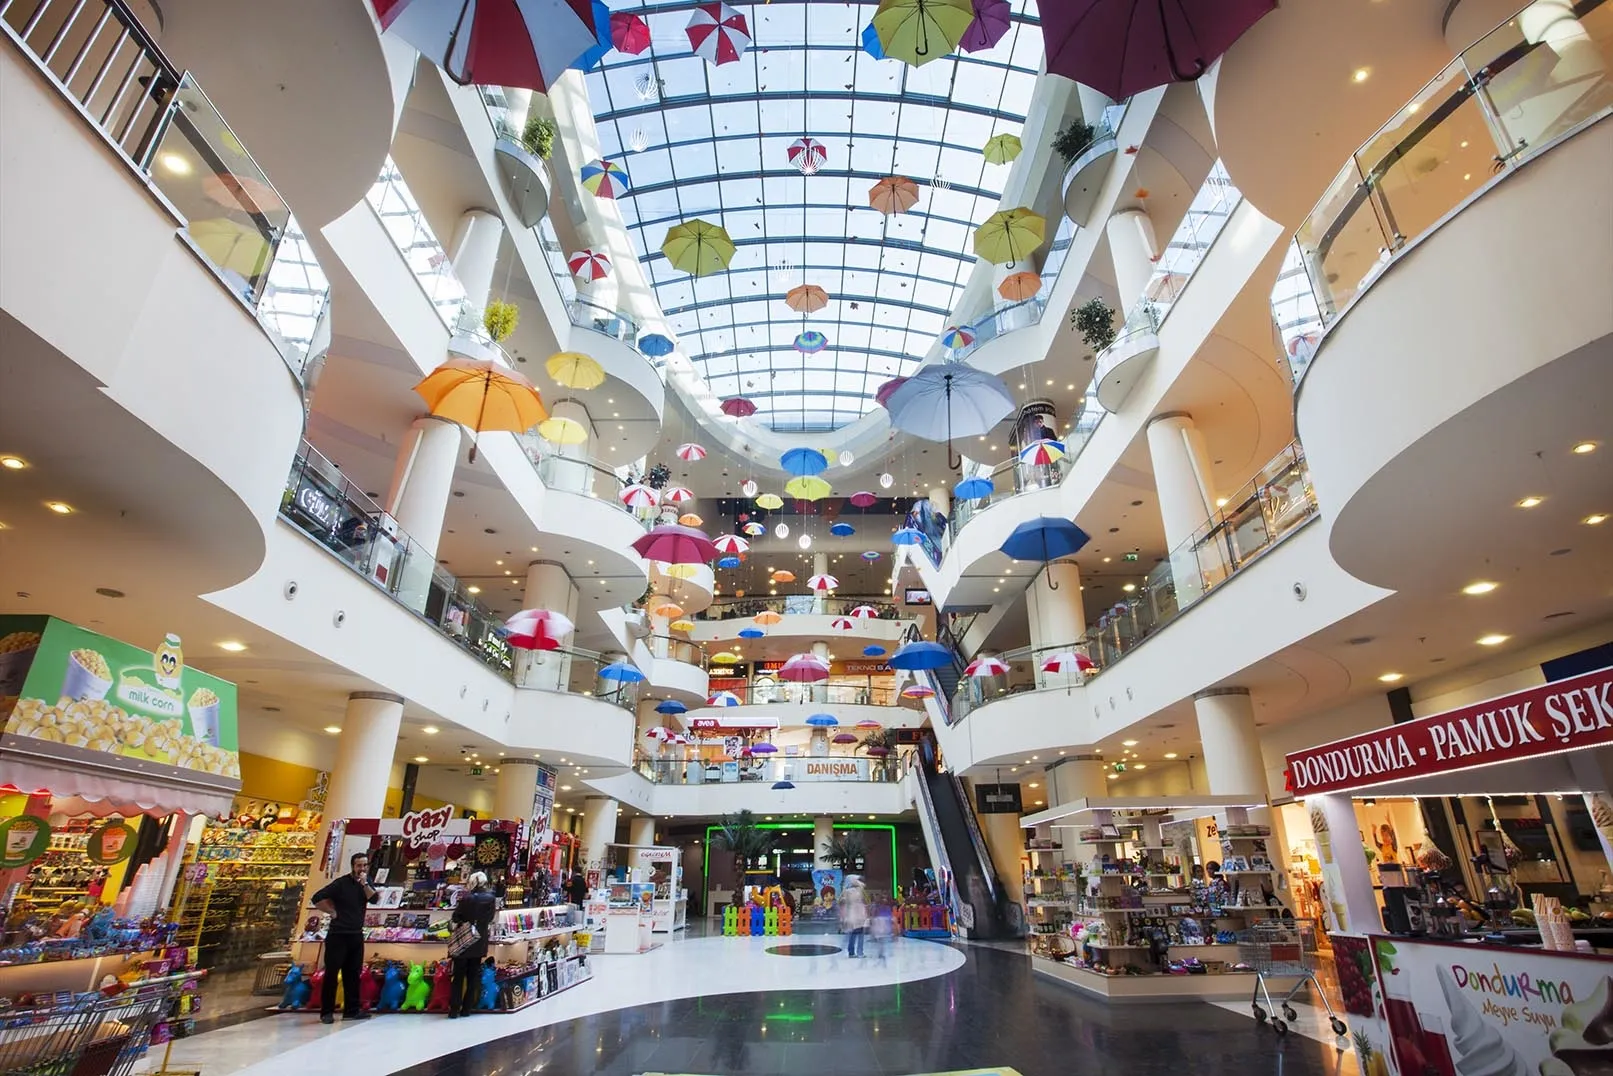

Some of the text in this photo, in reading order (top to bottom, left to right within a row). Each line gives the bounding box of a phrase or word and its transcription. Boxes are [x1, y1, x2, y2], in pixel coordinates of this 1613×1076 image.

[847, 663, 892, 672] TEKNOSA
[128, 690, 175, 712] milk corn
[1291, 733, 1417, 790] DONDURMA
[1427, 700, 1547, 762] PAMUK
[807, 763, 858, 776] DANIŞMA
[403, 806, 452, 836] Crazy
[413, 829, 440, 846] shop
[1482, 998, 1557, 1035] Meyve Suyu
